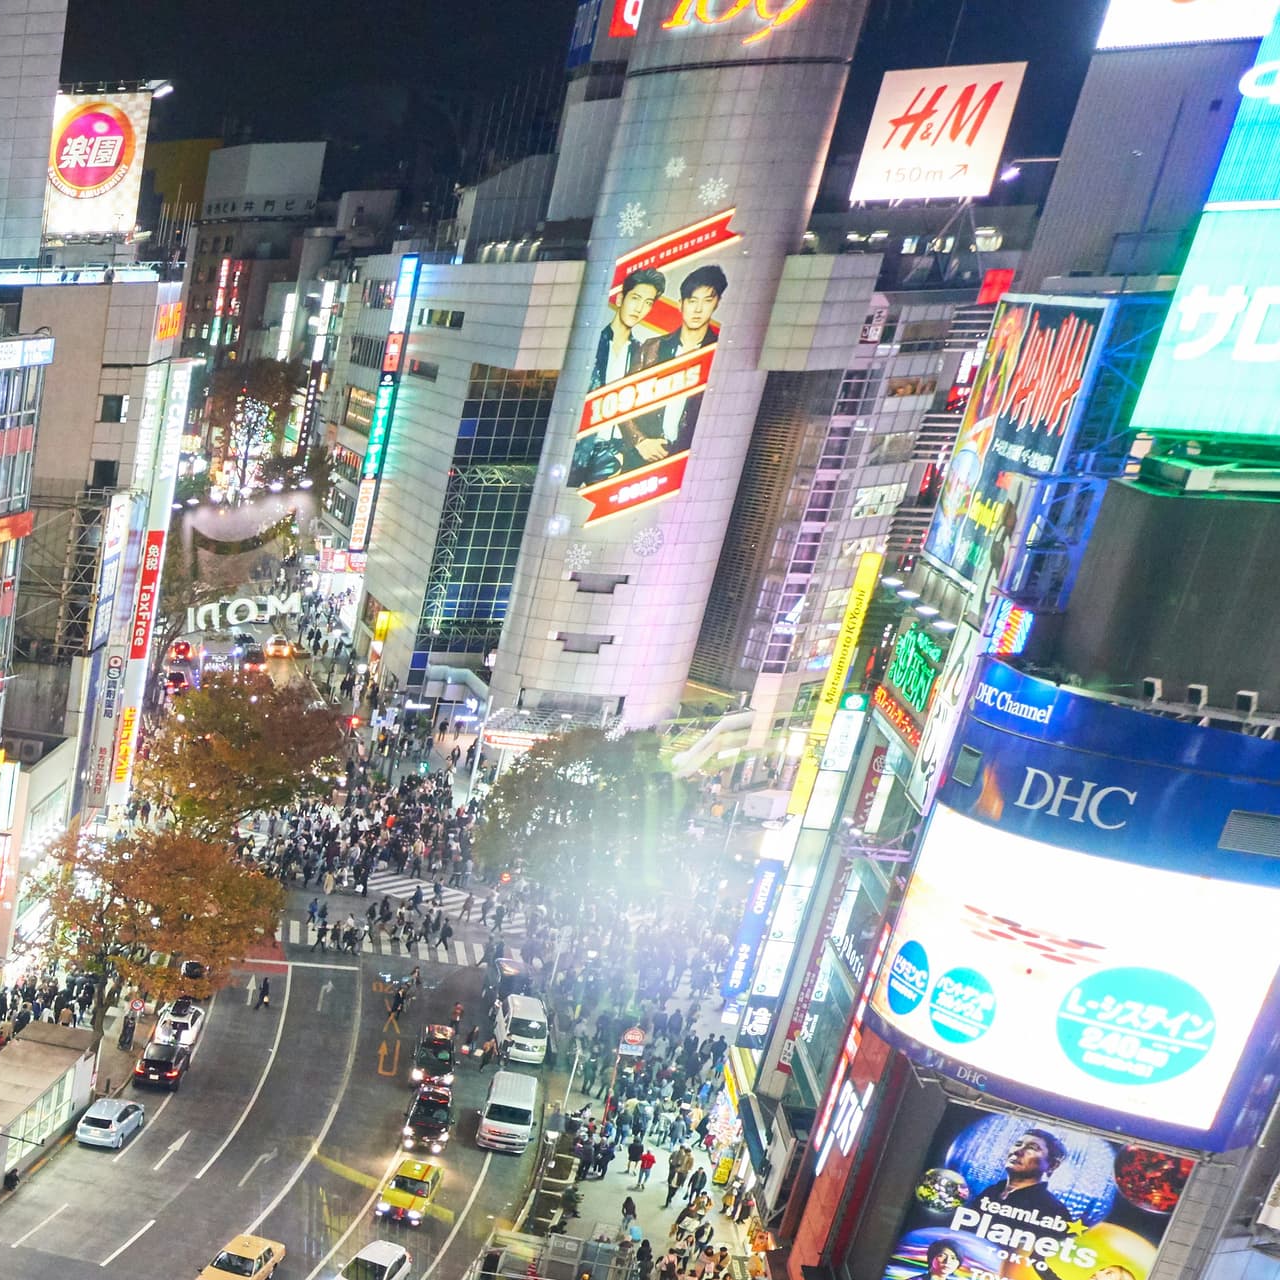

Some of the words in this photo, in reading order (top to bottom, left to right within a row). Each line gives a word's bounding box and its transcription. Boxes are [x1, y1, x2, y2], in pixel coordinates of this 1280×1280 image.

[882, 80, 1004, 151] H&M
[58, 135, 124, 169] 楽園
[883, 165, 944, 182] 150m
[659, 230, 718, 259] CHRISTMAS
[975, 681, 998, 710] DHC
[996, 685, 1053, 725] Channel
[1014, 766, 1138, 831] DHC
[956, 1065, 988, 1087] DHC
[979, 1196, 1068, 1234] teamLab
[950, 1206, 1100, 1269] Planets
[986, 1244, 1050, 1273] TOKYO
